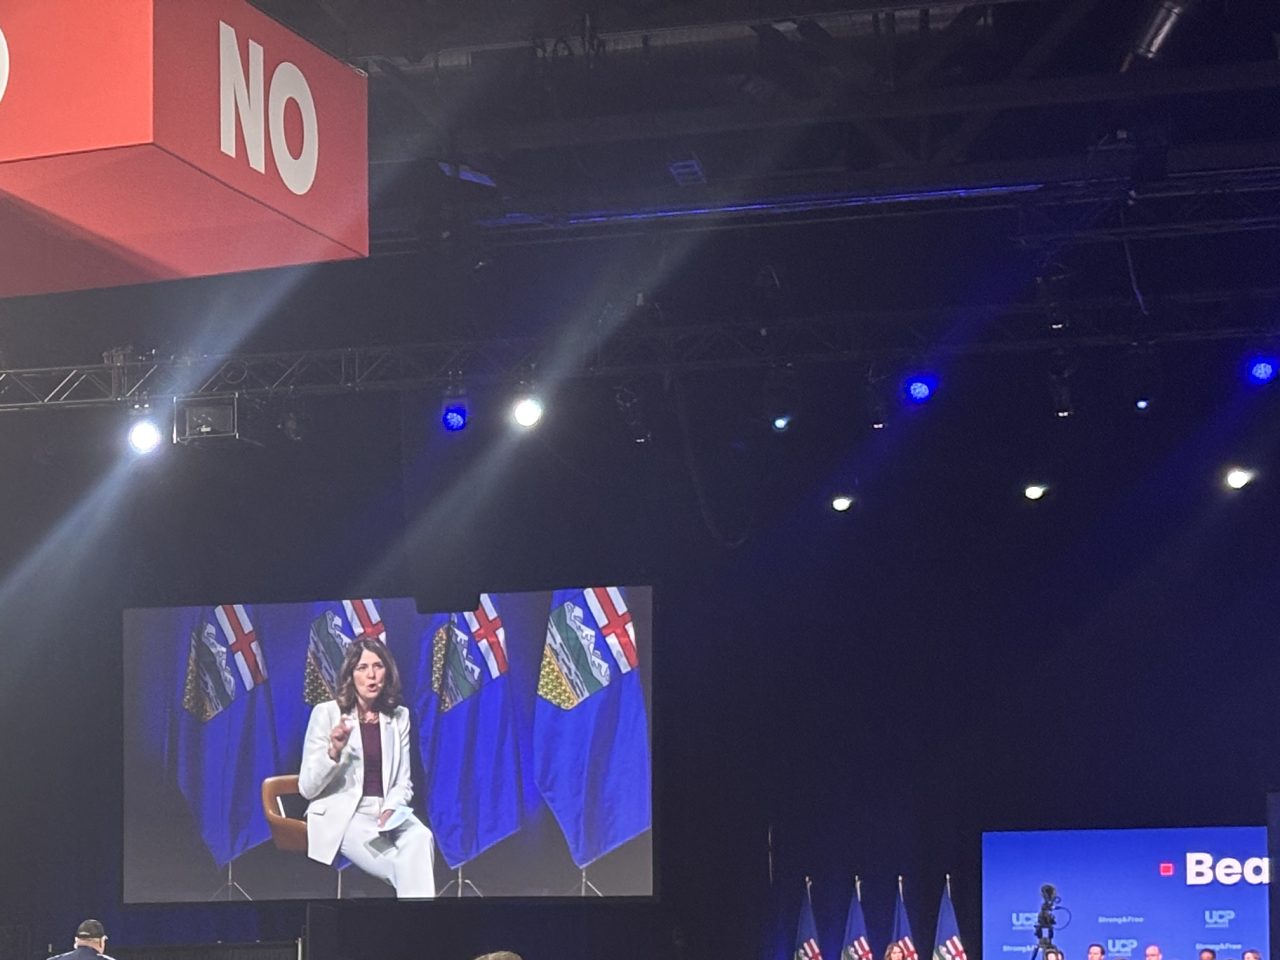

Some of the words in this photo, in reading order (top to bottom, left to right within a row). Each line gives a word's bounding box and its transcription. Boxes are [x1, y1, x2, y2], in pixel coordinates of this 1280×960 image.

[219, 20, 319, 196] NO
[1185, 852, 1269, 885] Bea
[1012, 912, 1039, 925] UC
[1204, 910, 1235, 925] UCP
[1108, 939, 1138, 952] UCP
